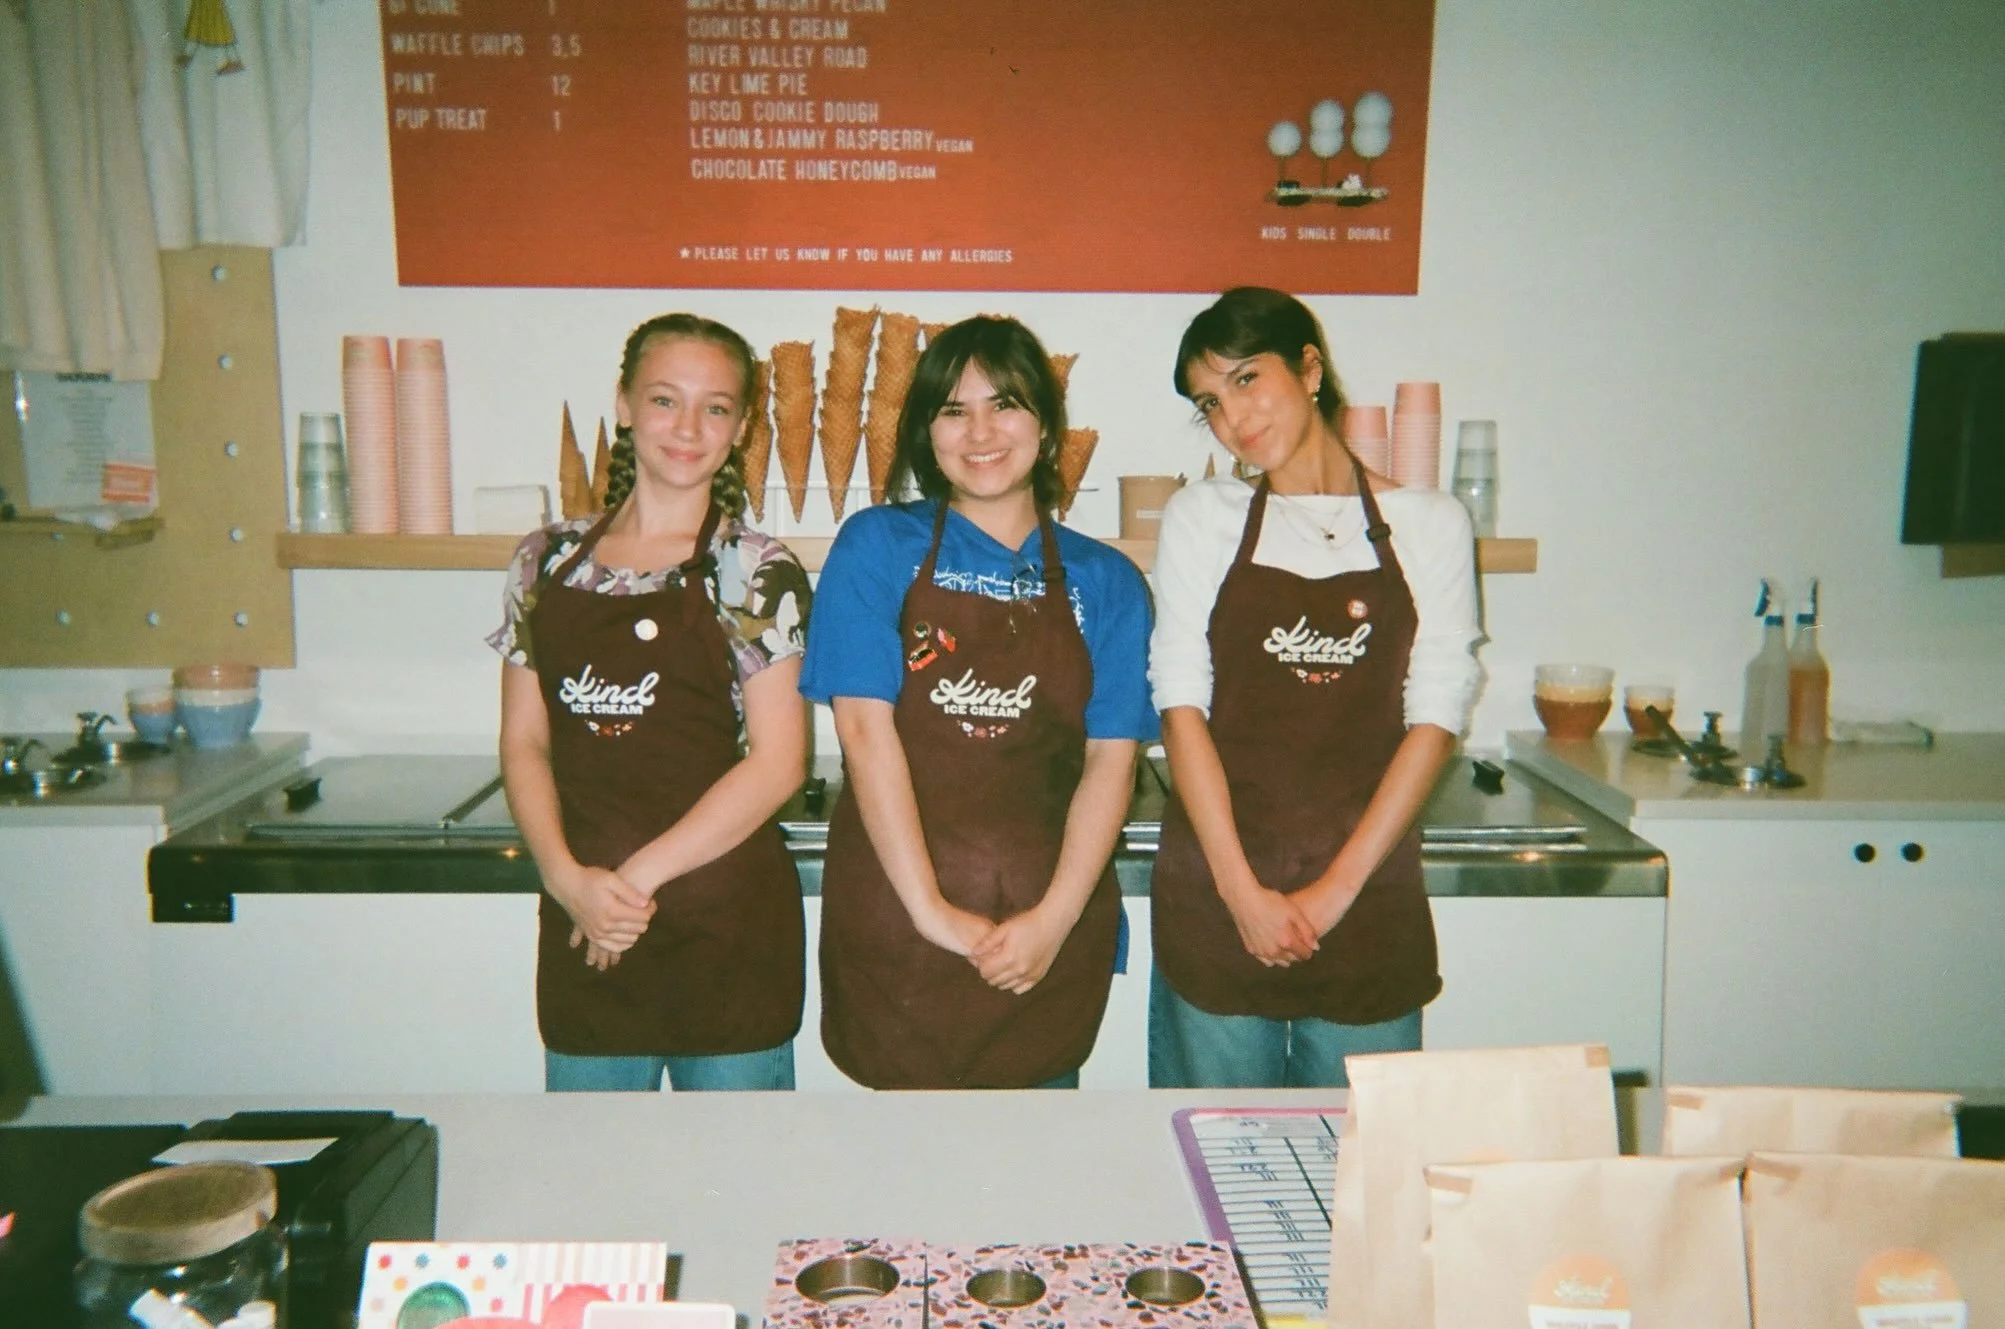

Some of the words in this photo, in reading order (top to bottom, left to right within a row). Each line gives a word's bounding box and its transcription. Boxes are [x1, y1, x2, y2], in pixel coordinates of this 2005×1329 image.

[687, 17, 762, 39] COOKIES
[769, 18, 781, 40] &
[789, 18, 848, 40] CREAM
[391, 33, 462, 56] WAFFLE
[471, 34, 525, 57] CHIPS
[551, 34, 581, 58] 3.5
[688, 44, 740, 66] RIVER
[748, 47, 814, 67] VALLEY
[825, 48, 868, 68] ROAD
[394, 73, 436, 94] PINT
[551, 75, 571, 96] 12
[689, 73, 721, 94] KEY
[730, 74, 769, 94] LIME
[778, 74, 807, 95] PIE
[396, 108, 428, 129] PUP
[436, 108, 486, 130] TREAT
[553, 111, 560, 131] 1
[690, 101, 741, 121] DISCO
[753, 102, 815, 122] COOKIE
[824, 103, 878, 122] DOUGH
[835, 130, 934, 150] RASPBERRY
[936, 140, 974, 153] VEGAN
[692, 159, 786, 179] CHOCOLATE
[795, 161, 897, 181] HONEYCOMB
[900, 166, 936, 179] VEGAN
[1261, 227, 1287, 240] KIDS
[1298, 227, 1336, 240] SINGLE
[1348, 227, 1391, 241] DOUBLE
[695, 248, 738, 260] PLEASE
[746, 248, 768, 260] LET
[775, 248, 790, 261] US
[797, 249, 829, 261] KNOW
[837, 249, 848, 261] IF
[856, 249, 877, 262] YOU
[885, 249, 913, 262] HAVE
[921, 249, 943, 262] ANY
[950, 249, 1013, 262] ALLERGIES
[1263, 615, 1372, 656] Kind
[1278, 653, 1301, 662] ICE
[1303, 653, 1353, 664] CREAM
[559, 664, 660, 706] Kind
[930, 668, 1036, 709] Kind
[571, 703, 591, 713] ICE
[592, 704, 643, 715] CREAM
[944, 704, 967, 715] ICE
[969, 705, 1020, 718] CREAM
